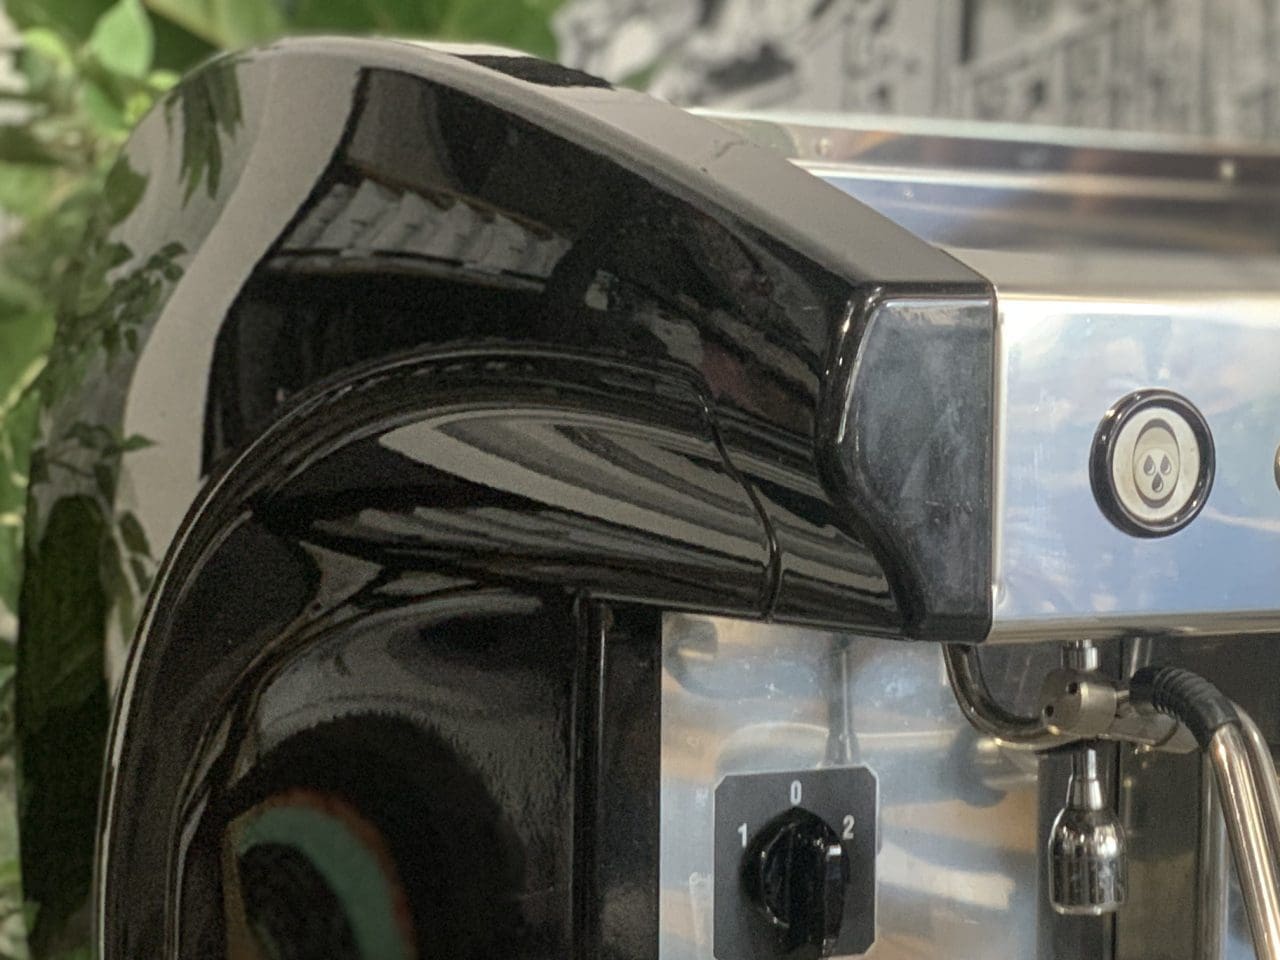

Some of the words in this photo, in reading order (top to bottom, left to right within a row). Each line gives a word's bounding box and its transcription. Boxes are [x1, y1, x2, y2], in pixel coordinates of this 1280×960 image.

[789, 780, 803, 806] 0
[737, 822, 749, 848] 1
[842, 815, 856, 840] 2
